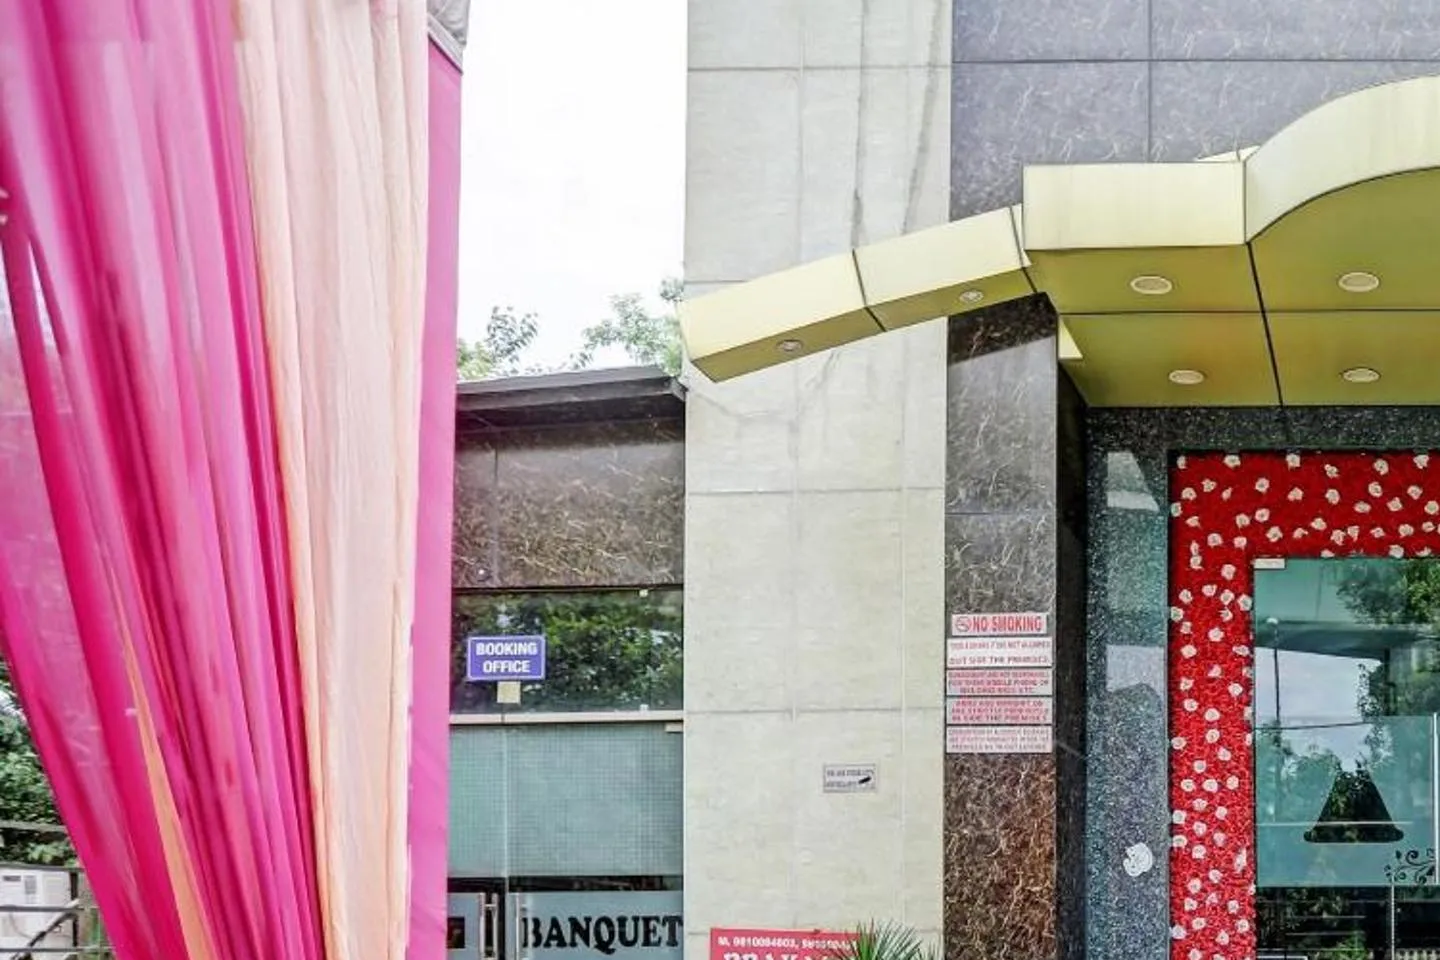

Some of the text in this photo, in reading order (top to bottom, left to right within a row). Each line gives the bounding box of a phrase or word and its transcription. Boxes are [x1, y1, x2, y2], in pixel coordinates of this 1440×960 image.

[972, 615, 1042, 633] NO SMOKING
[475, 642, 538, 656] BOOKING
[482, 660, 531, 673] OFFICE
[521, 915, 683, 955] BANQUET
